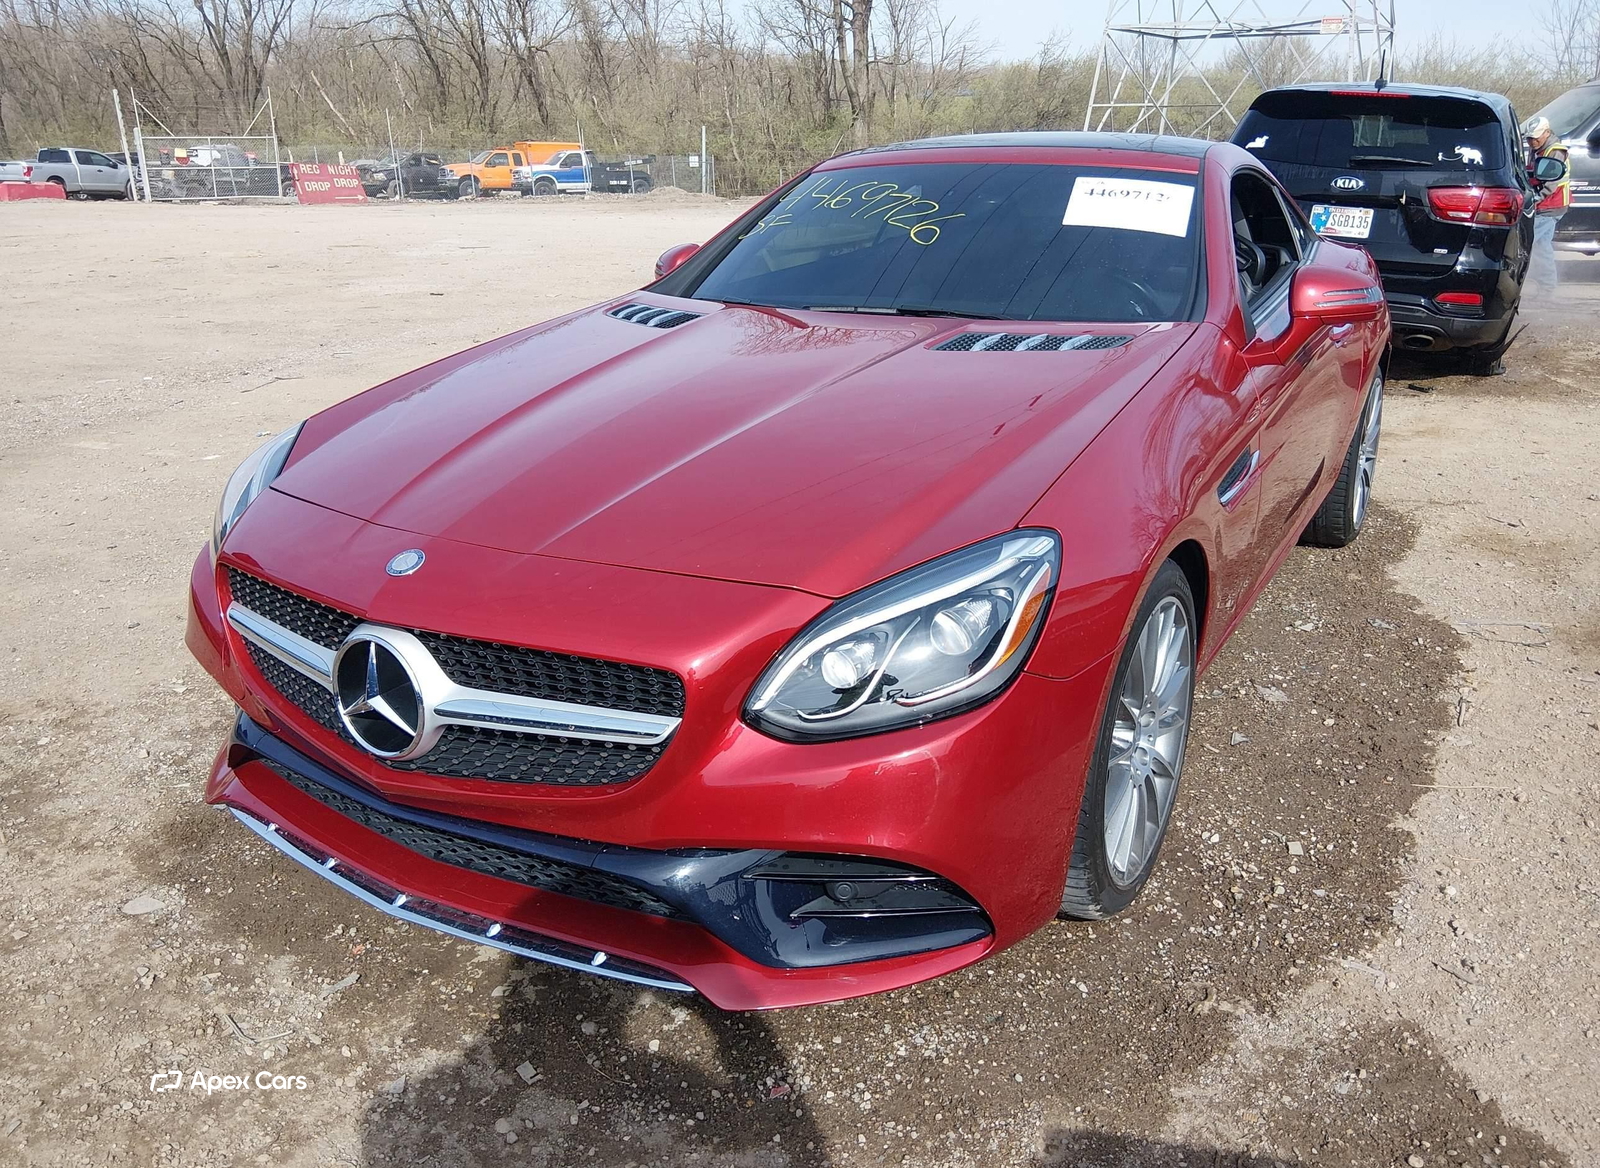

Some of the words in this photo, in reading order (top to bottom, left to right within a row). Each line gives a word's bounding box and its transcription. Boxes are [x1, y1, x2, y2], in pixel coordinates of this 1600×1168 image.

[300, 164, 320, 174] REG
[327, 165, 357, 175] NIGHT
[304, 181, 331, 192] DROP
[333, 178, 359, 188] DROP
[1336, 178, 1357, 189] KIA
[1084, 187, 1171, 203] 4469712
[1330, 213, 1370, 230] SGB135
